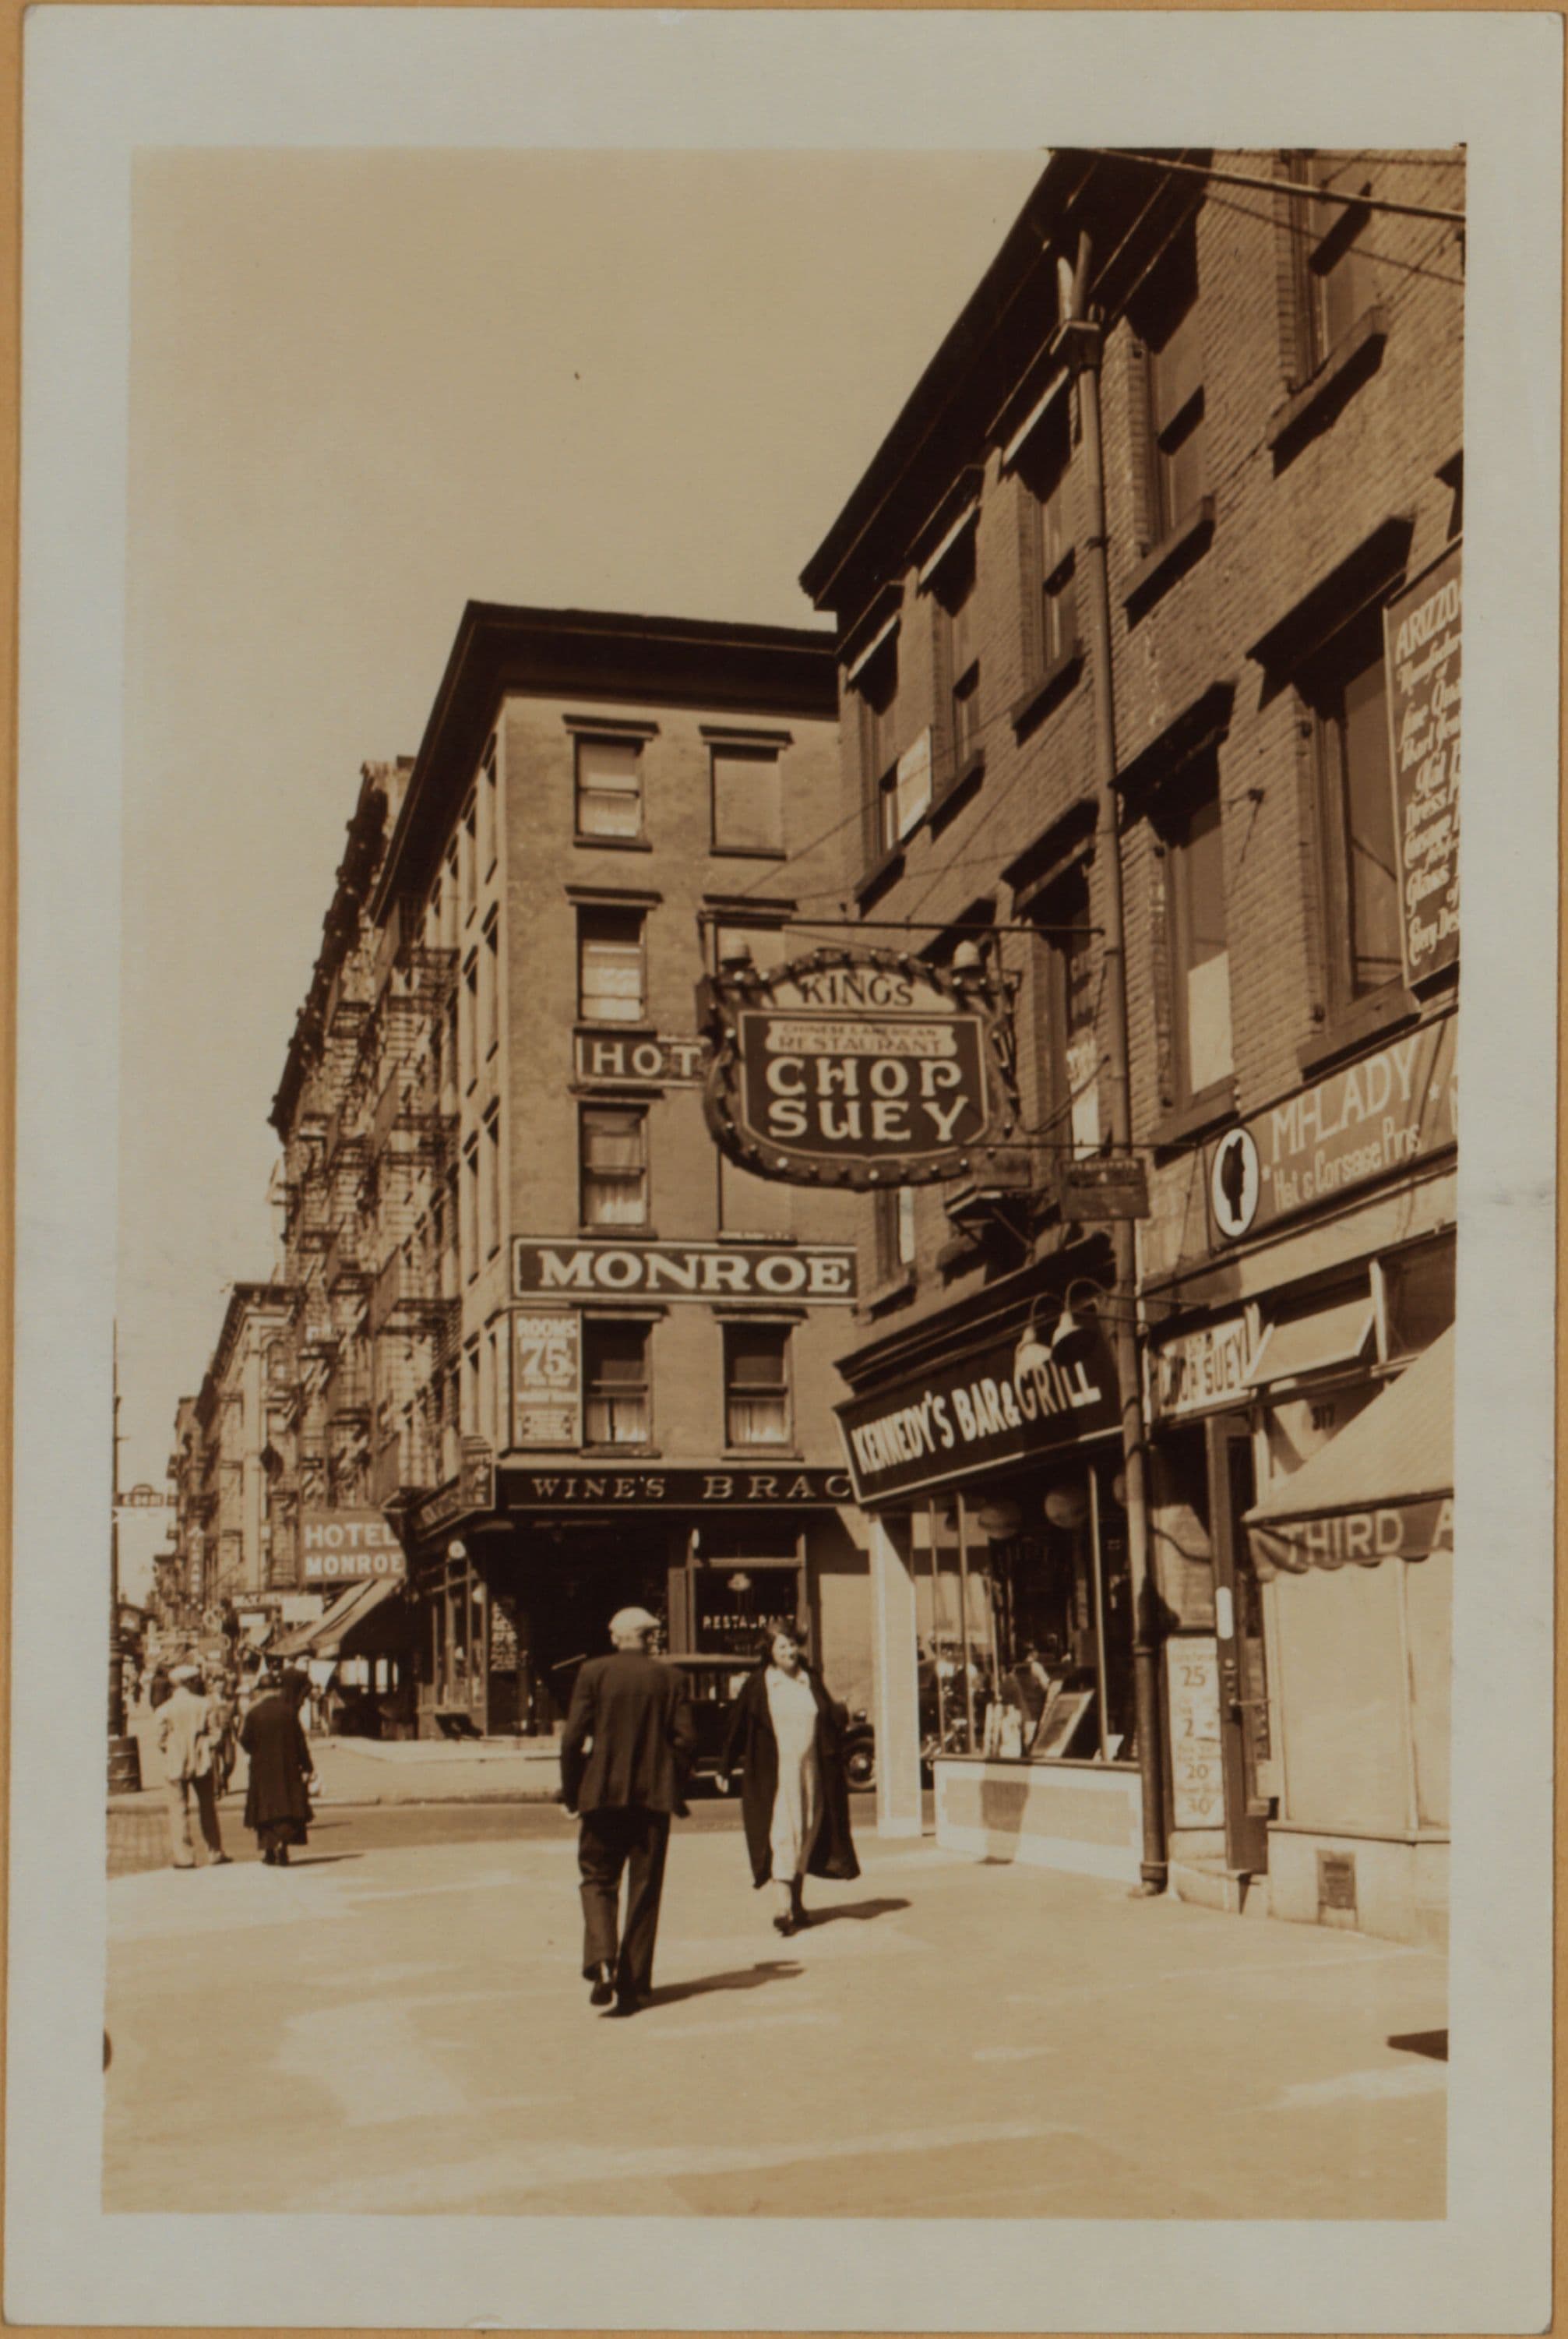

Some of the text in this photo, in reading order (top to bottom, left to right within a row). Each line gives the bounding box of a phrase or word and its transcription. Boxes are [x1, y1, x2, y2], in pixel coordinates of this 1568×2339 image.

[778, 1036, 941, 1054] RESTAURANT
[766, 1056, 963, 1099] CHOP
[767, 1095, 970, 1141] SUEY
[537, 1249, 851, 1293] MONROE
[851, 1389, 955, 1475] KENNEDY'S
[1016, 1360, 1102, 1422] GRILL
[532, 1476, 667, 1500] WINE'S
[305, 1522, 400, 1549] HOTEL
[1279, 1510, 1405, 1565] THIRD
[305, 1553, 405, 1577] MONROE
